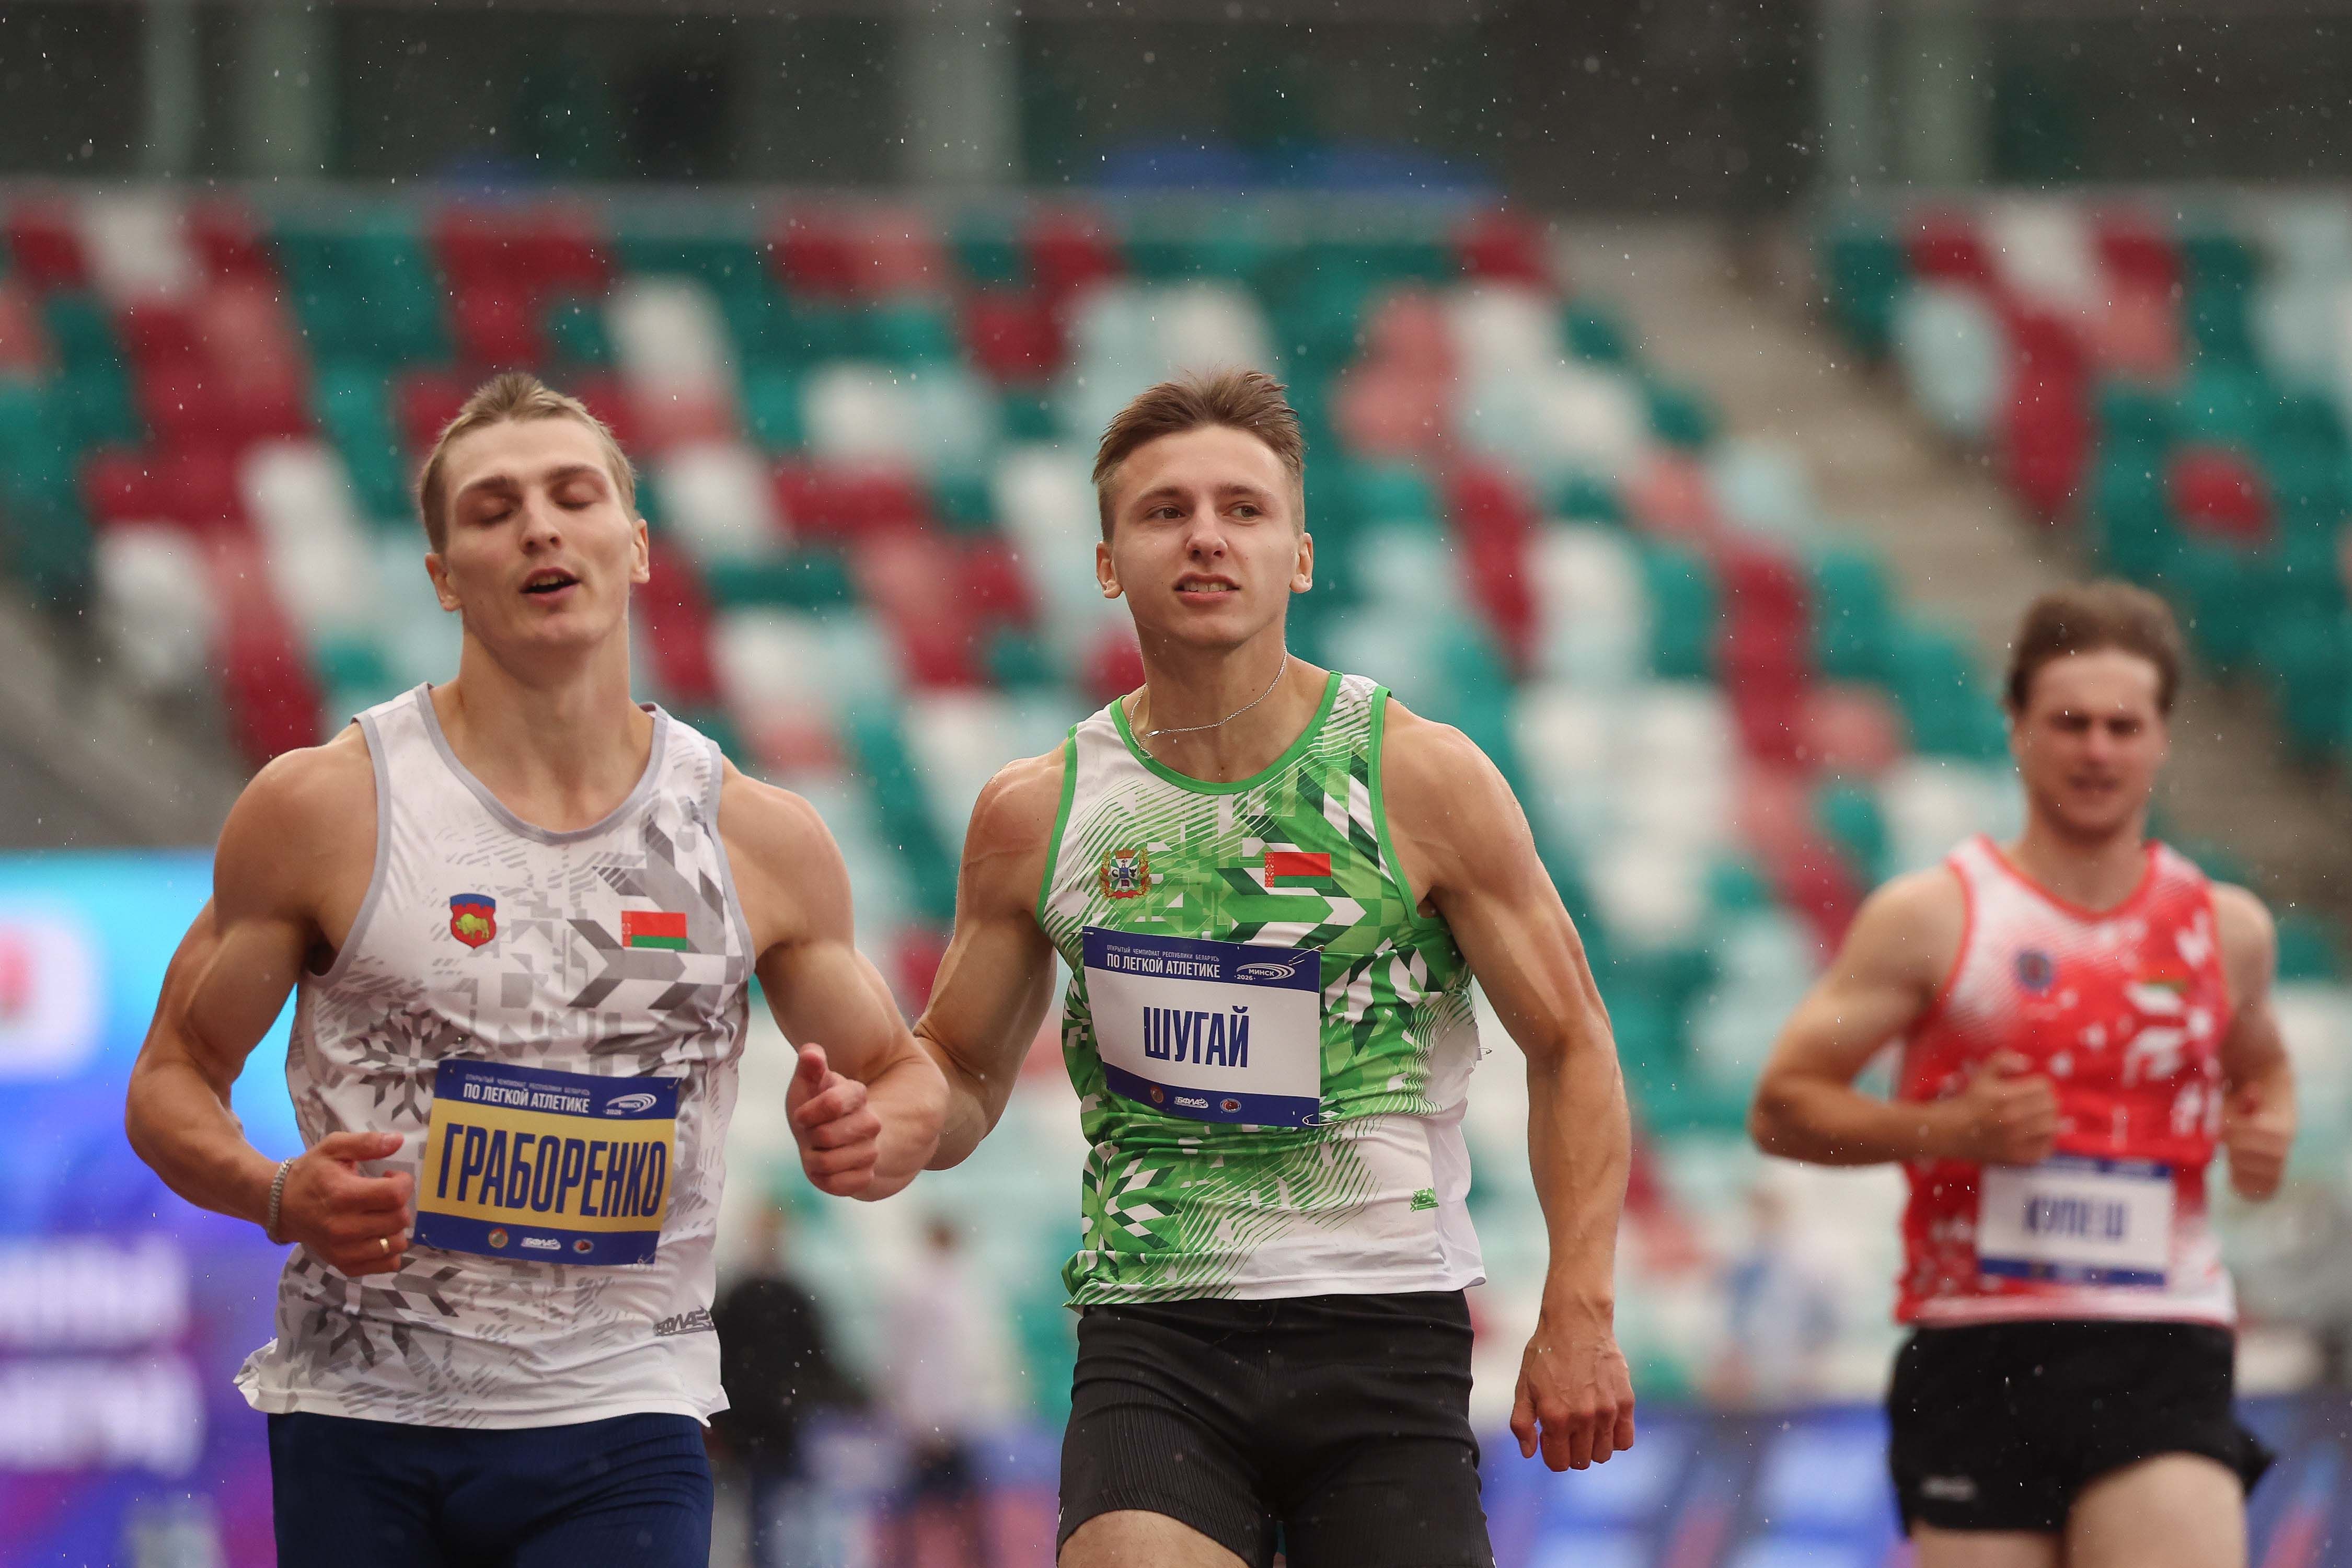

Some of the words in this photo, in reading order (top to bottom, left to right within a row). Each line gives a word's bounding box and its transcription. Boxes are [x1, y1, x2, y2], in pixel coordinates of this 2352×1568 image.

[1106, 944, 1131, 953] ОТКРЫТЫЙ
[1133, 948, 1160, 956] ЧЕМПИОНАТ
[1162, 951, 1193, 960] РЕСПУБЛИКИ
[1195, 954, 1220, 962] БЕЛАРУСЬ
[1107, 953, 1120, 968] ПО
[1122, 955, 1163, 973] ЛЕГКОЙ
[1166, 960, 1220, 978] АТЛЕТИКЕ
[1143, 1005, 1249, 1068] ШУГАЙ
[463, 1082, 480, 1100] ПО
[481, 1085, 529, 1106] ЛЕГКОЙ
[531, 1092, 590, 1113] АТЛЕТИКЕ
[436, 1122, 666, 1218] ГРАБОРЕНКО
